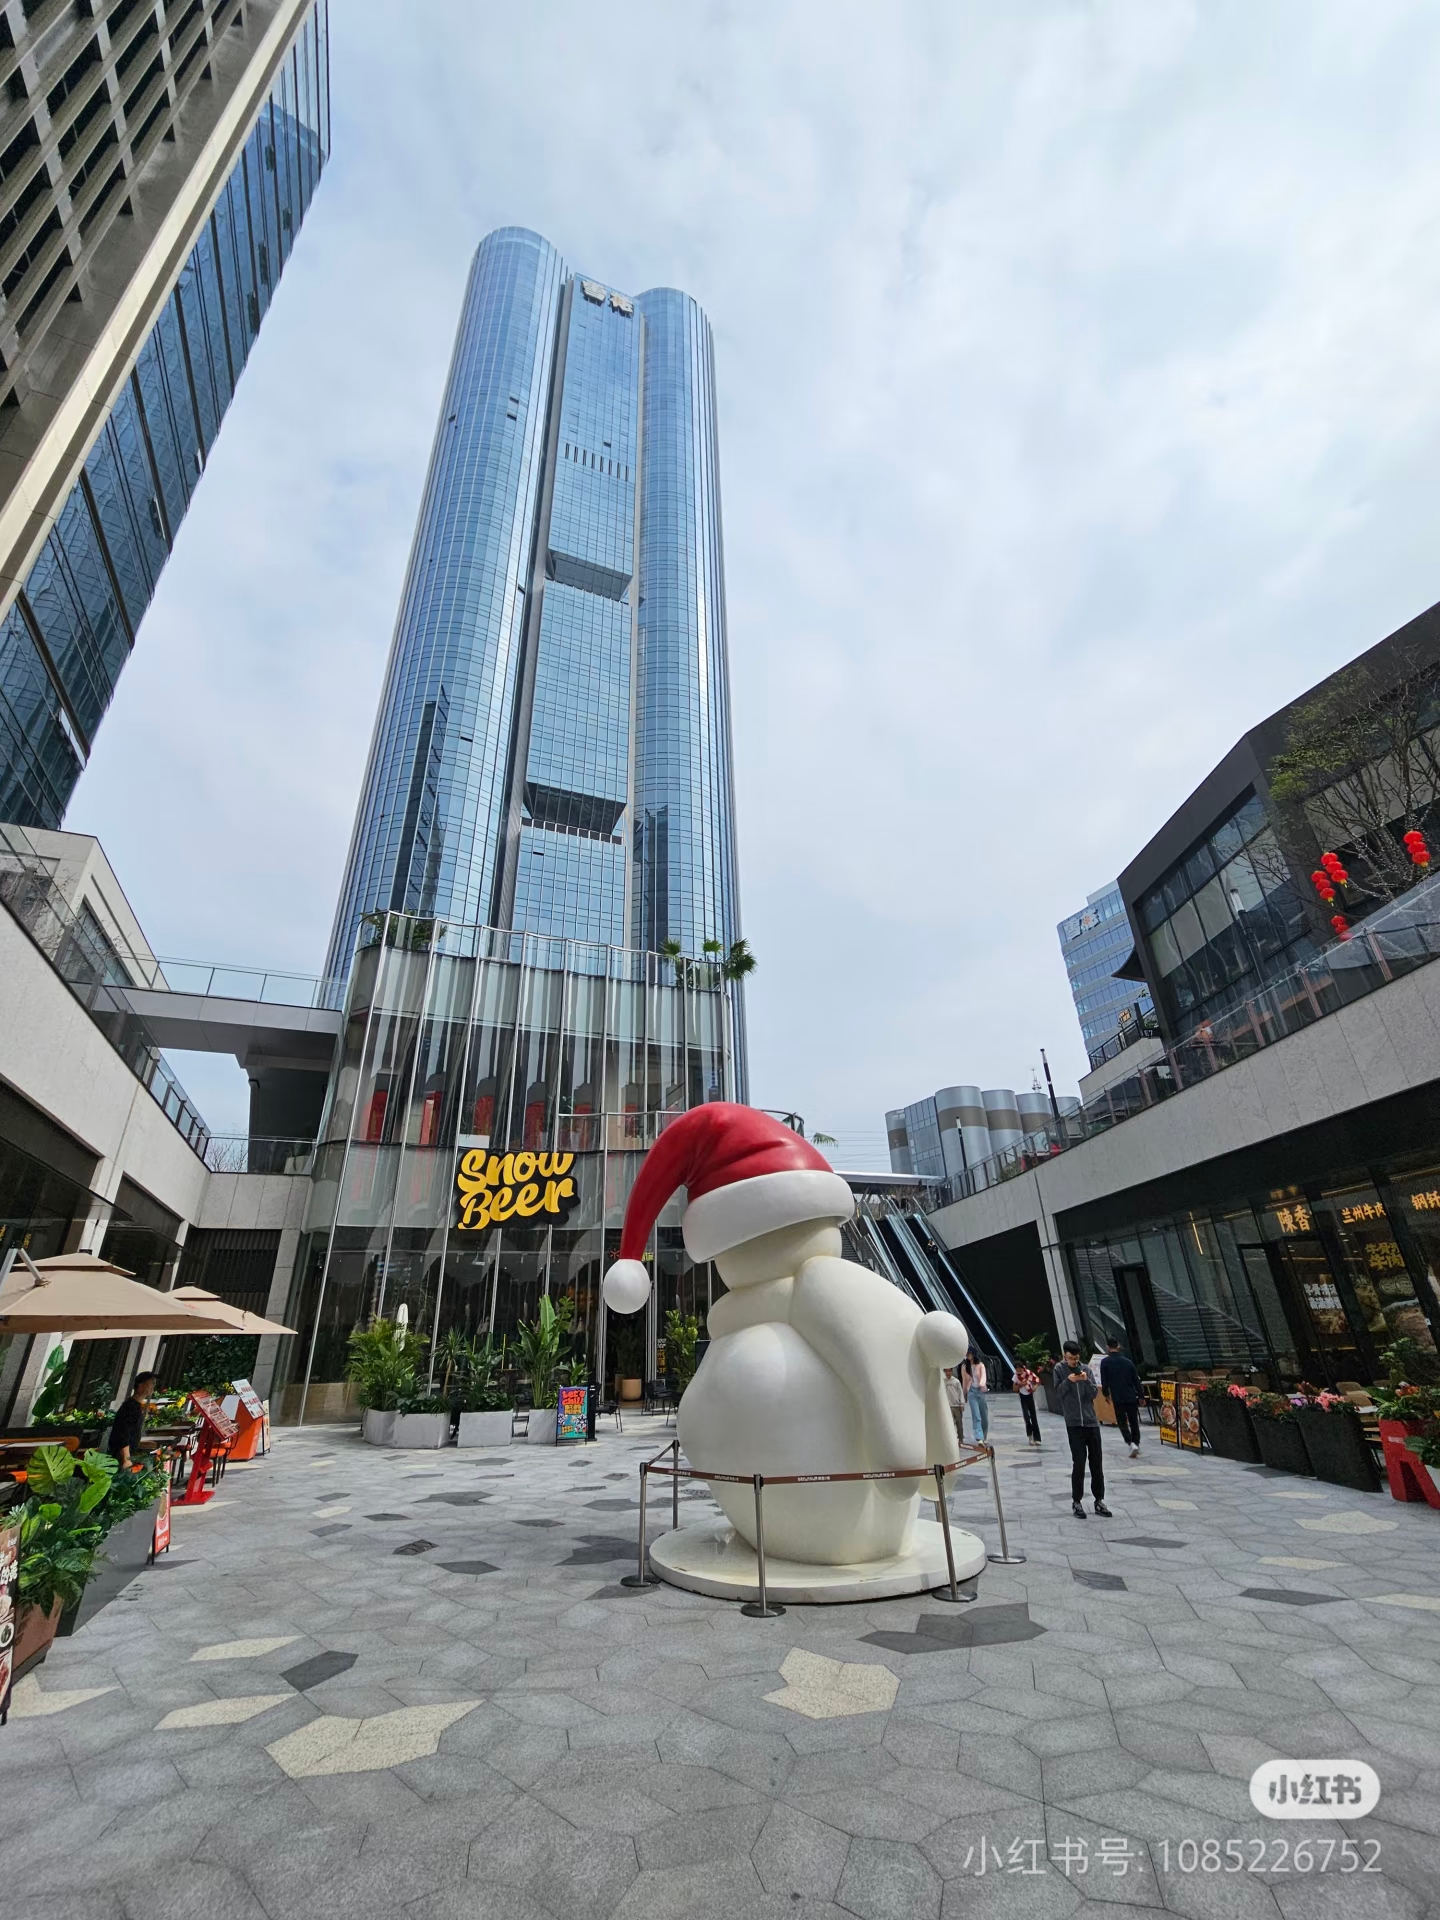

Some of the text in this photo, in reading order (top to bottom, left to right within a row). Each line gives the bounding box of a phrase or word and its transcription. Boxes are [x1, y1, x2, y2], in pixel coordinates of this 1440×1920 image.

[457, 1149, 574, 1193] Snow
[457, 1178, 575, 1230] Beer
[1276, 1204, 1312, 1234] 陳香
